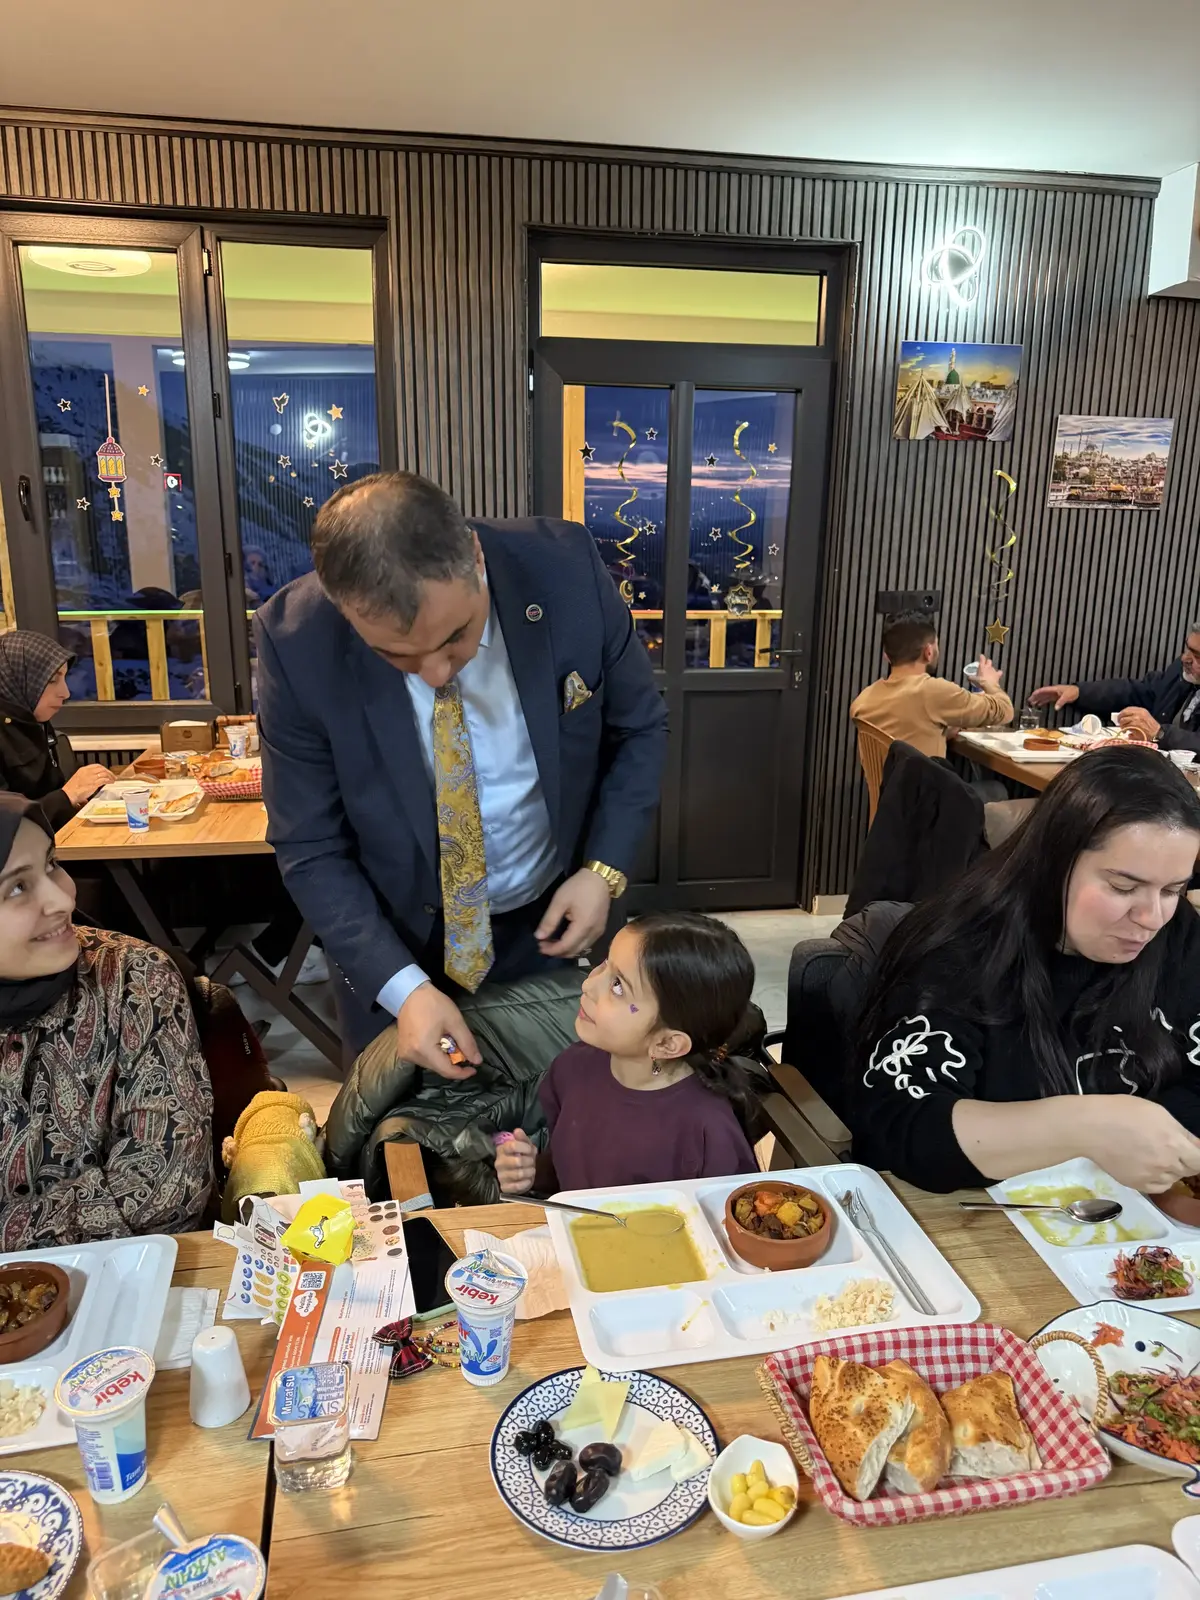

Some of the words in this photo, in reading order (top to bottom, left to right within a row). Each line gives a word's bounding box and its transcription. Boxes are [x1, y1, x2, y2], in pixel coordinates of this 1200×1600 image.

[455, 1283, 499, 1305] kebir
[93, 1371, 146, 1407] kebir
[165, 1545, 228, 1589] AYRAN
